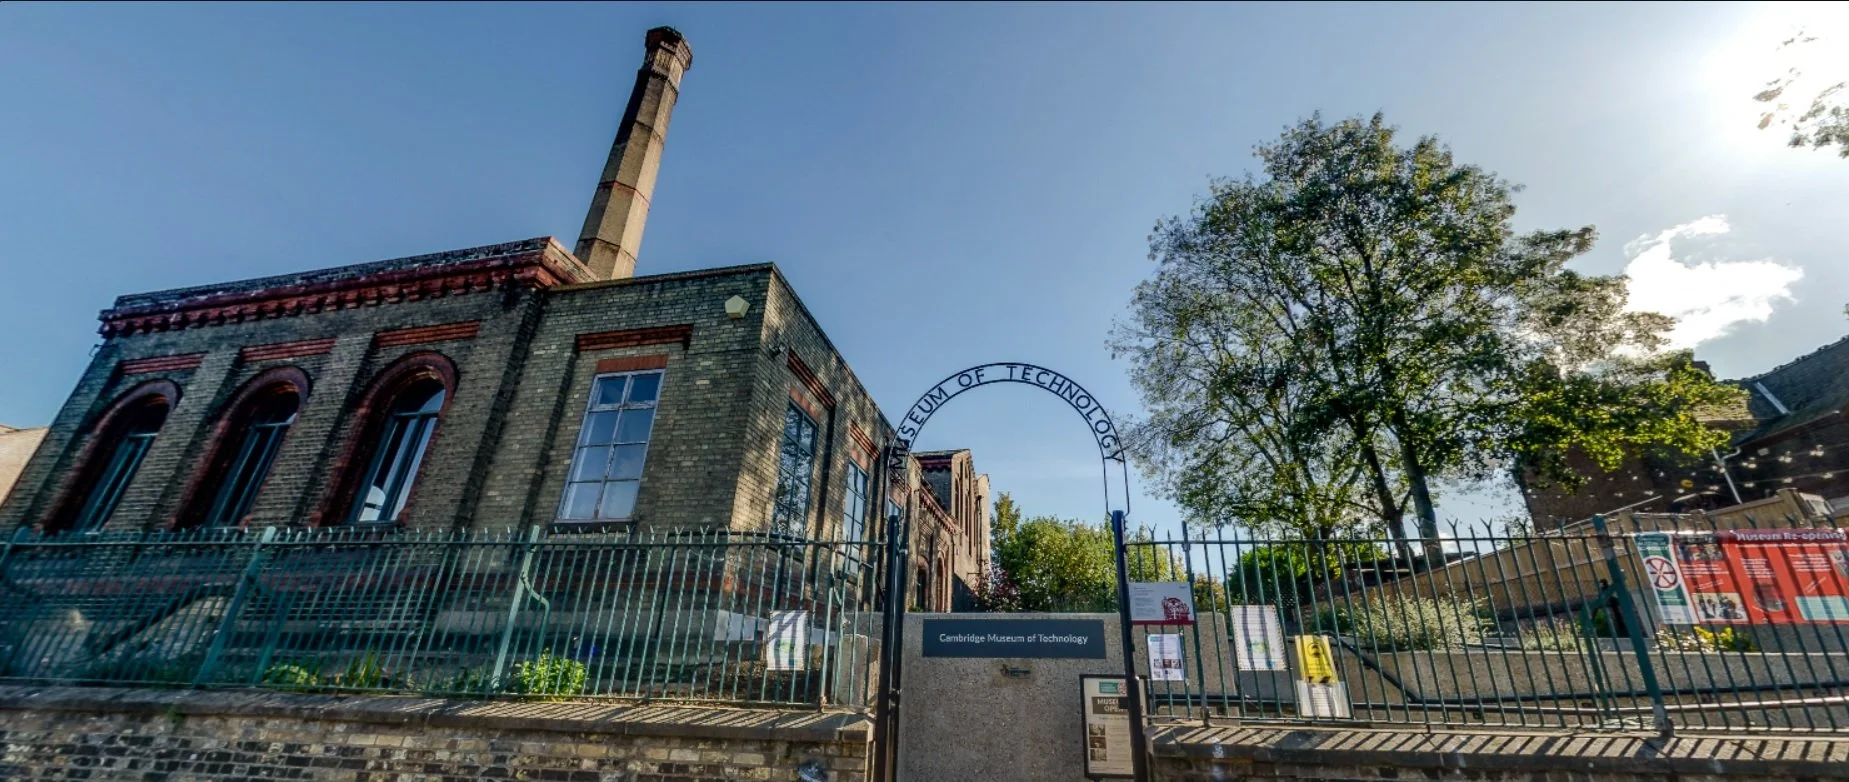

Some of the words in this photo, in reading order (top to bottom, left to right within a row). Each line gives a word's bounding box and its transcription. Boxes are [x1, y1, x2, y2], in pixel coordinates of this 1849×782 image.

[890, 386, 949, 470] MUSEUM
[958, 368, 985, 389] OF
[1006, 365, 1124, 463] TECHNOLOGY
[1736, 532, 1782, 541] Museum
[939, 633, 985, 644] Cambridge
[987, 633, 1025, 643] Museum
[1027, 633, 1036, 643] of
[1038, 633, 1088, 645] Technology
